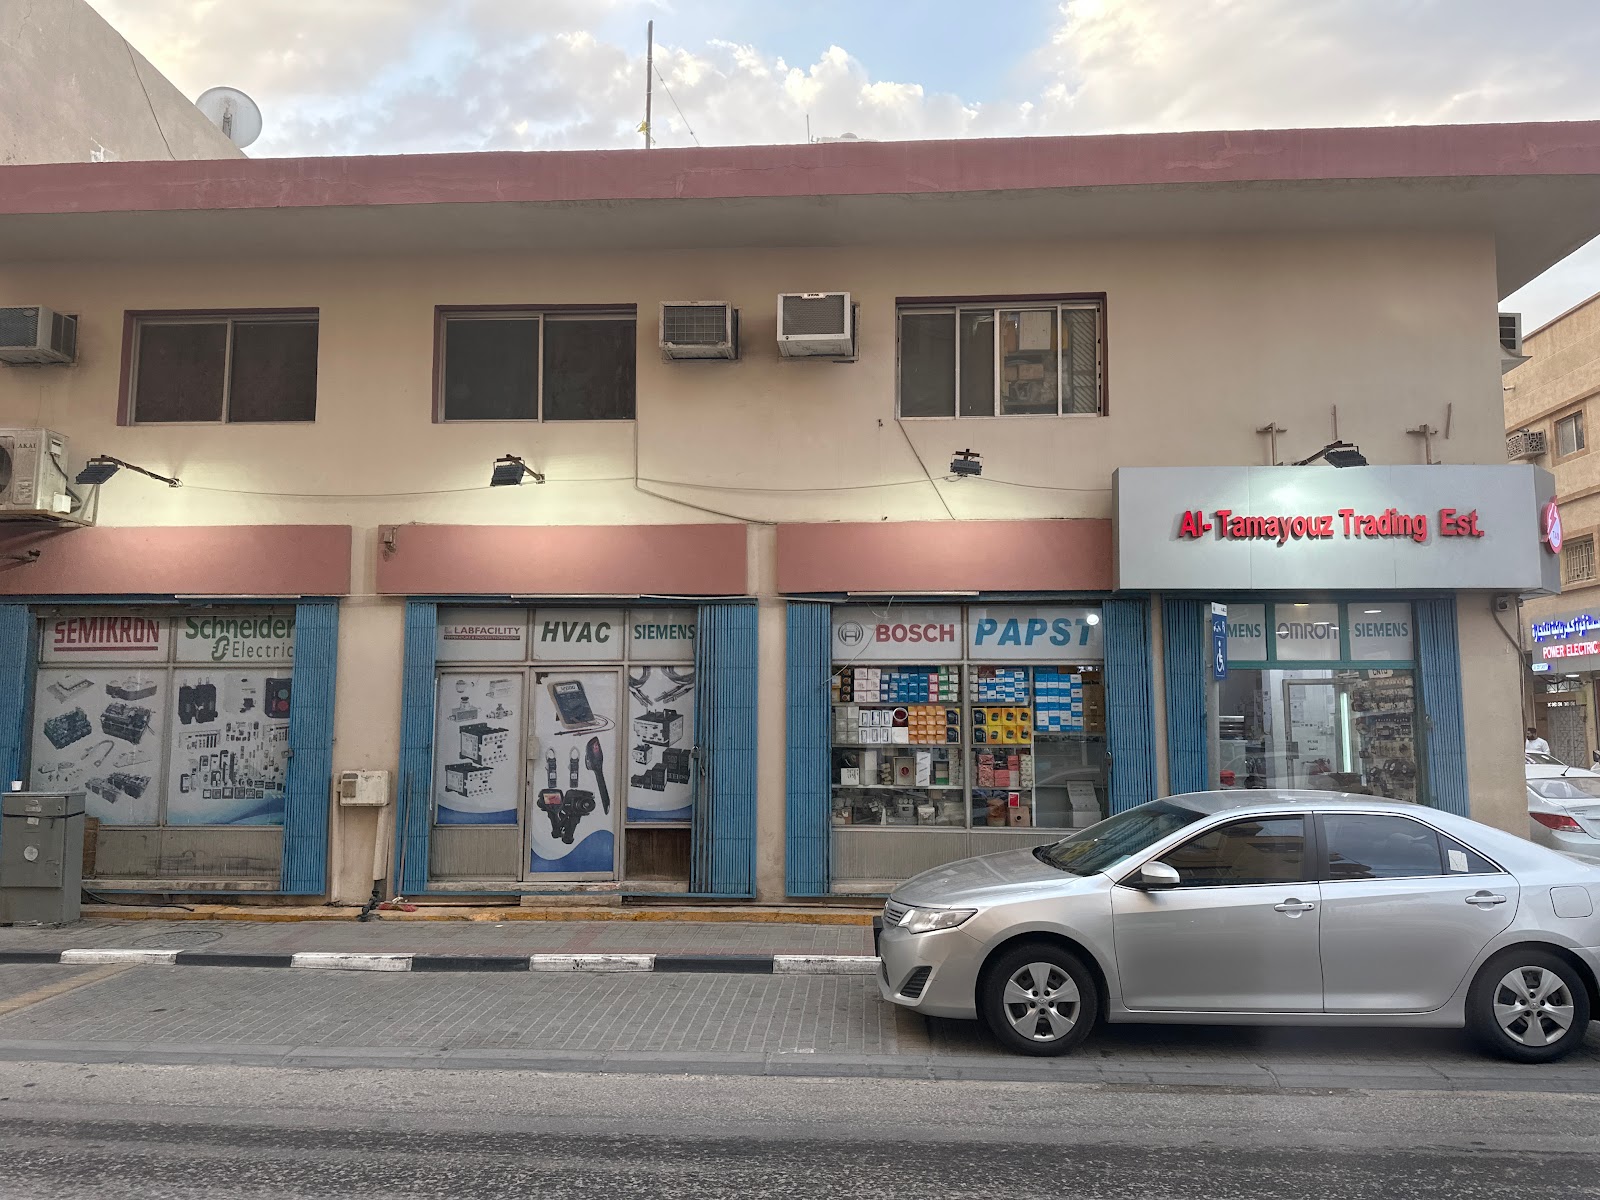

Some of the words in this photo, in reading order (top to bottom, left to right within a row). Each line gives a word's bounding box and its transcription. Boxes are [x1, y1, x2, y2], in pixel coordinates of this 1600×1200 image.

[1215, 509, 1335, 543] Tamayouz
[1338, 508, 1427, 542] Trading
[1439, 508, 1485, 538] Est.
[54, 616, 160, 643] SEMIKRON
[185, 615, 296, 640] Schneider
[454, 626, 520, 635] LABFACILITY
[541, 621, 611, 643] HVAC
[634, 624, 695, 640] SIEMENS
[875, 623, 955, 643] BOSCH
[974, 618, 1097, 646] PAPST
[1227, 623, 1262, 638] MENS
[1354, 622, 1409, 638] SIEMENS
[232, 640, 294, 658] Electric
[1542, 645, 1566, 659] POWER
[1566, 641, 1600, 656] ELECTRIC
